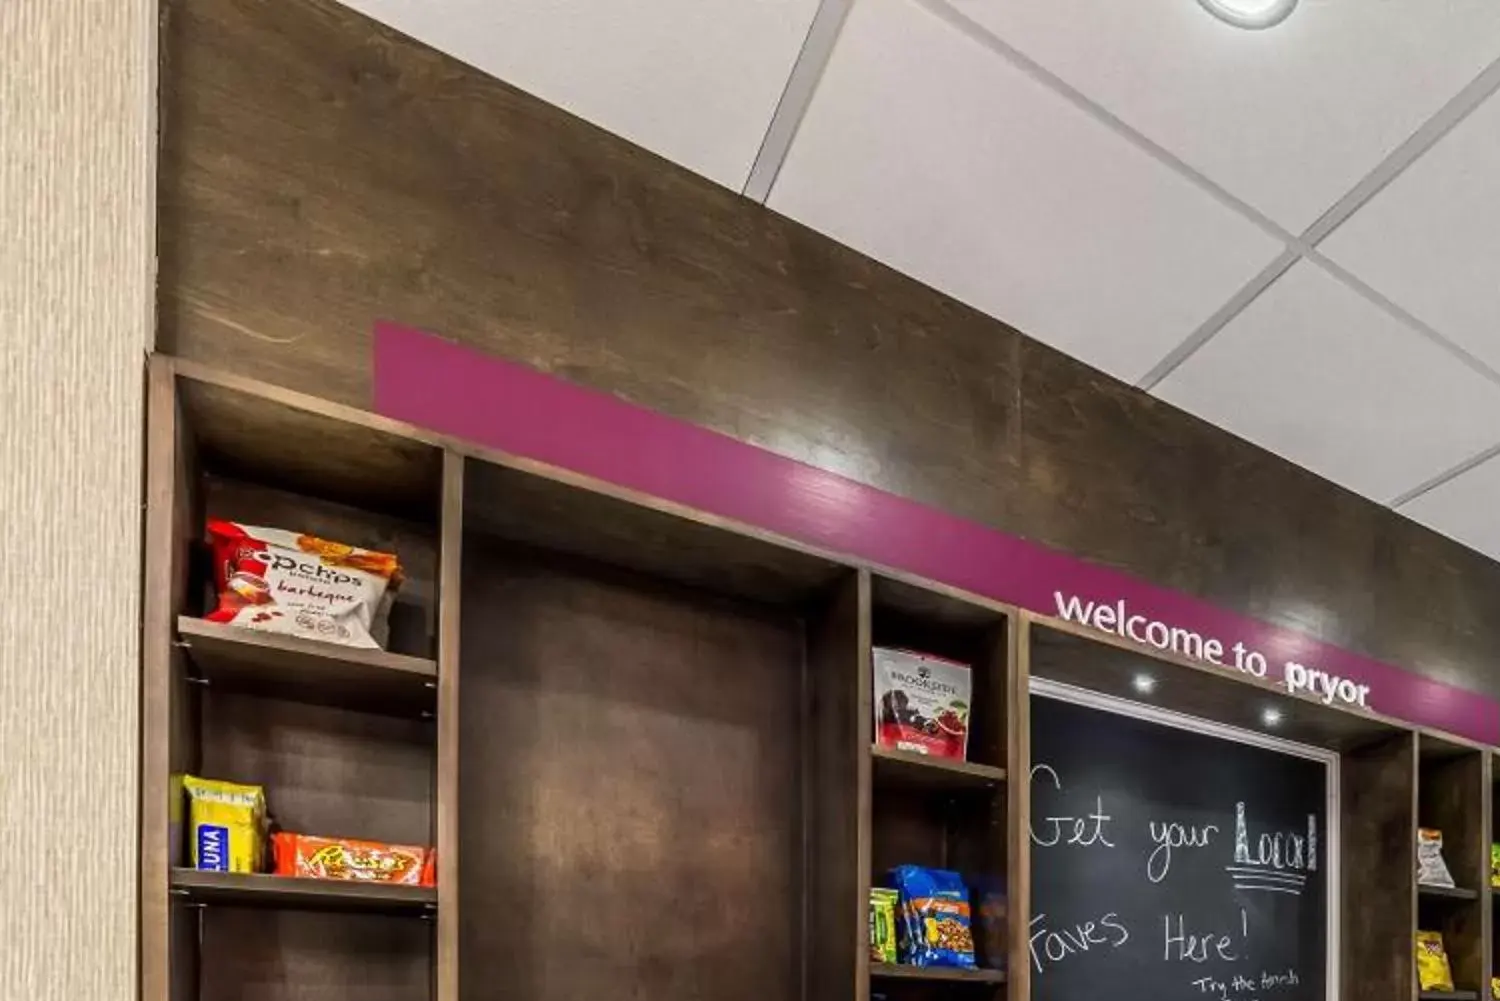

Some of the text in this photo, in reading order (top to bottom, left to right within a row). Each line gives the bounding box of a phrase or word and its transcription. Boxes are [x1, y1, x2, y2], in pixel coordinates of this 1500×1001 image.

[1054, 590, 1370, 707] welcome to pryor
[1029, 763, 1317, 883] Get your Local
[1028, 907, 1249, 974] Faves Here!
